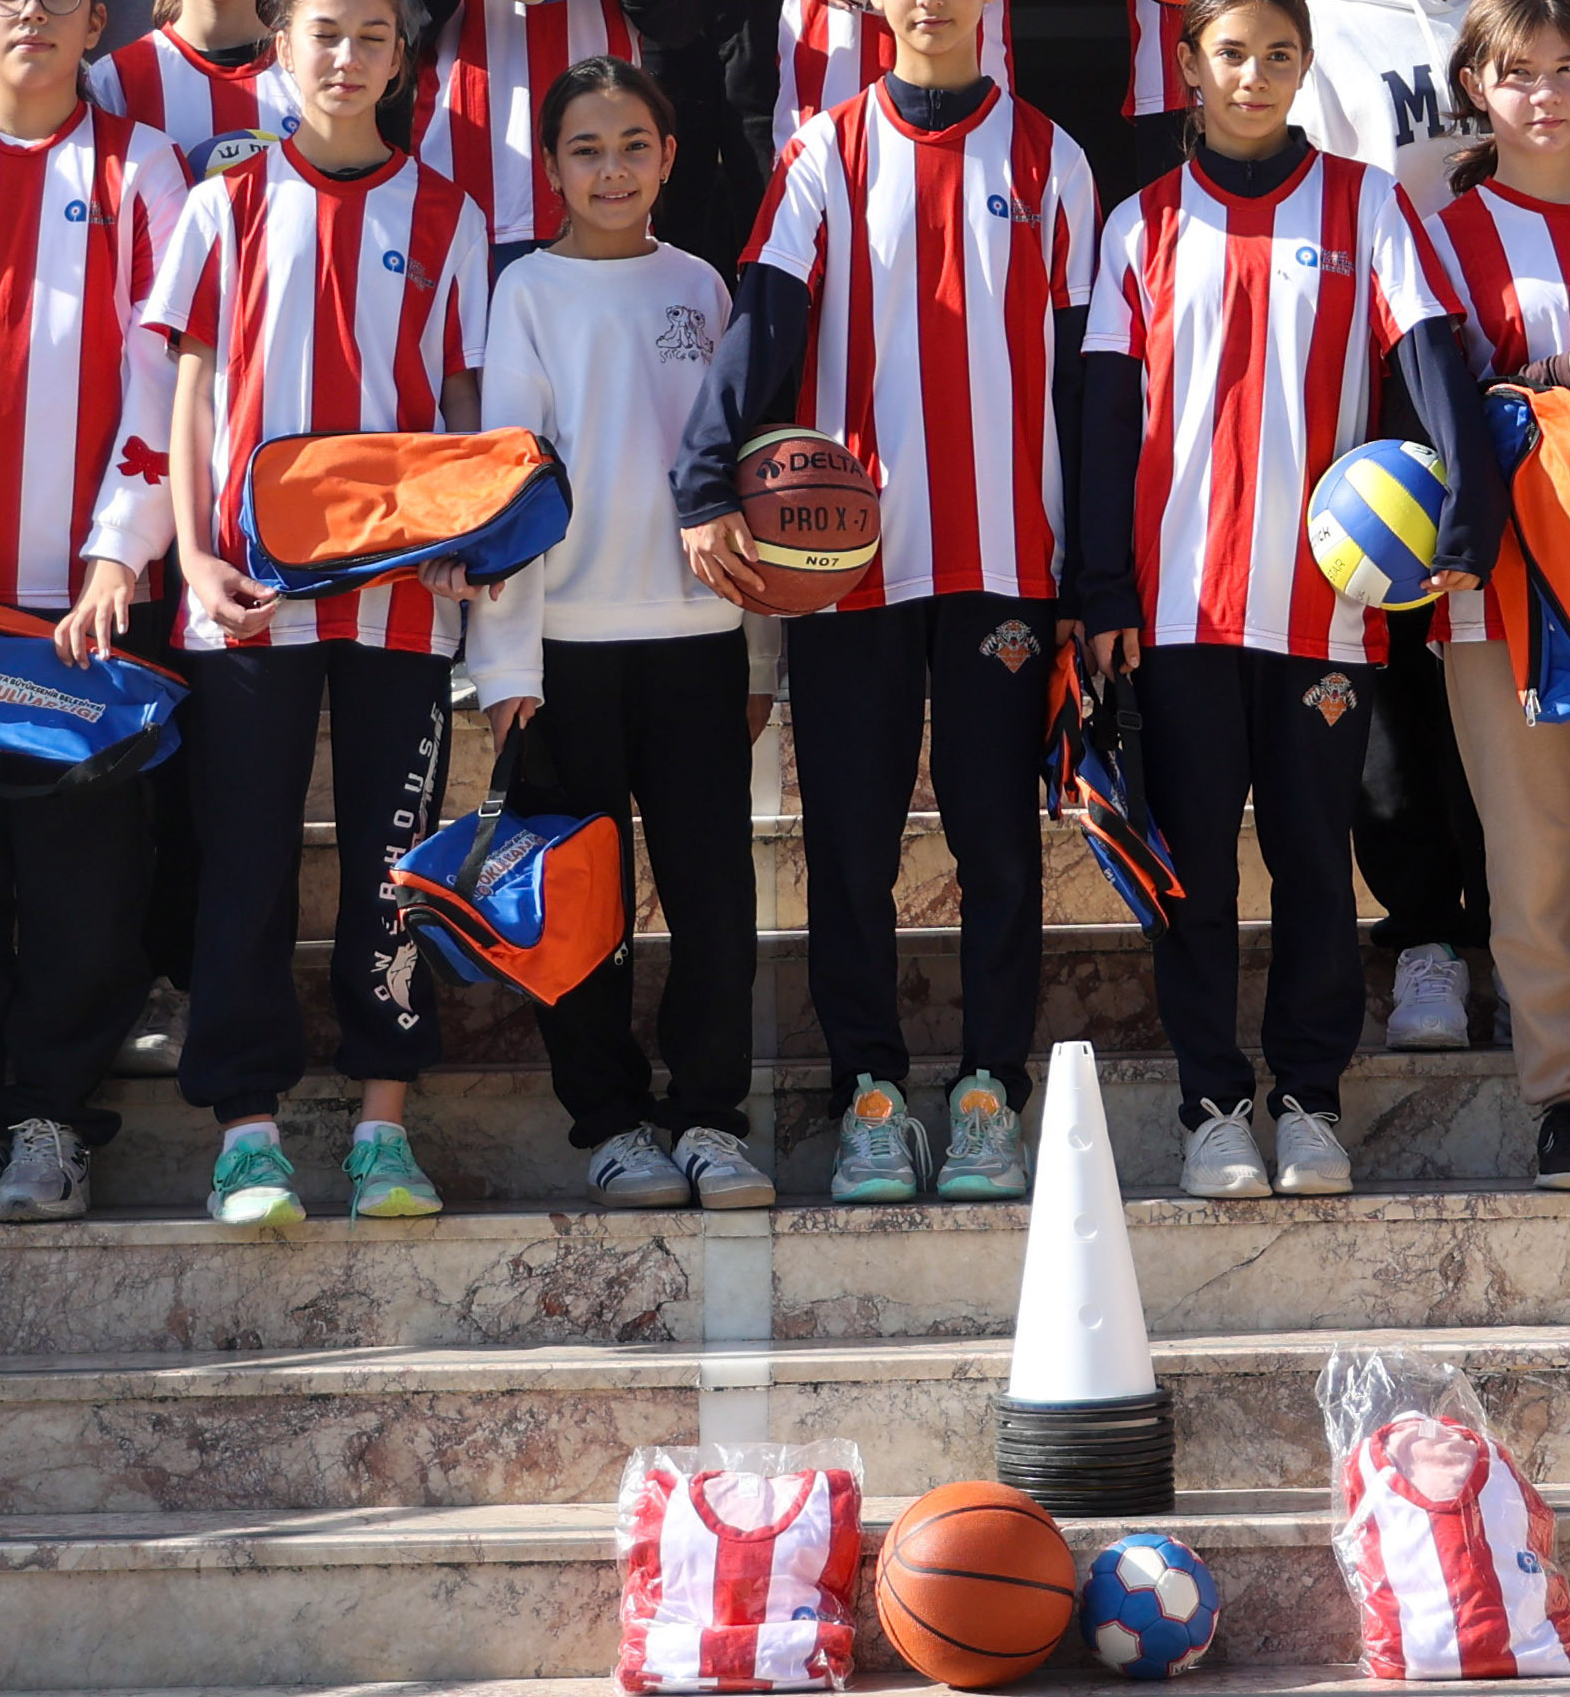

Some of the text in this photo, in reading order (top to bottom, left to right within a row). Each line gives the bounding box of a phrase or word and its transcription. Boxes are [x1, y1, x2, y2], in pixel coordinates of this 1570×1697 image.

[789, 452, 864, 479] DELTA
[780, 506, 829, 532] PRO
[835, 506, 847, 532] X
[805, 555, 840, 567] NO7
